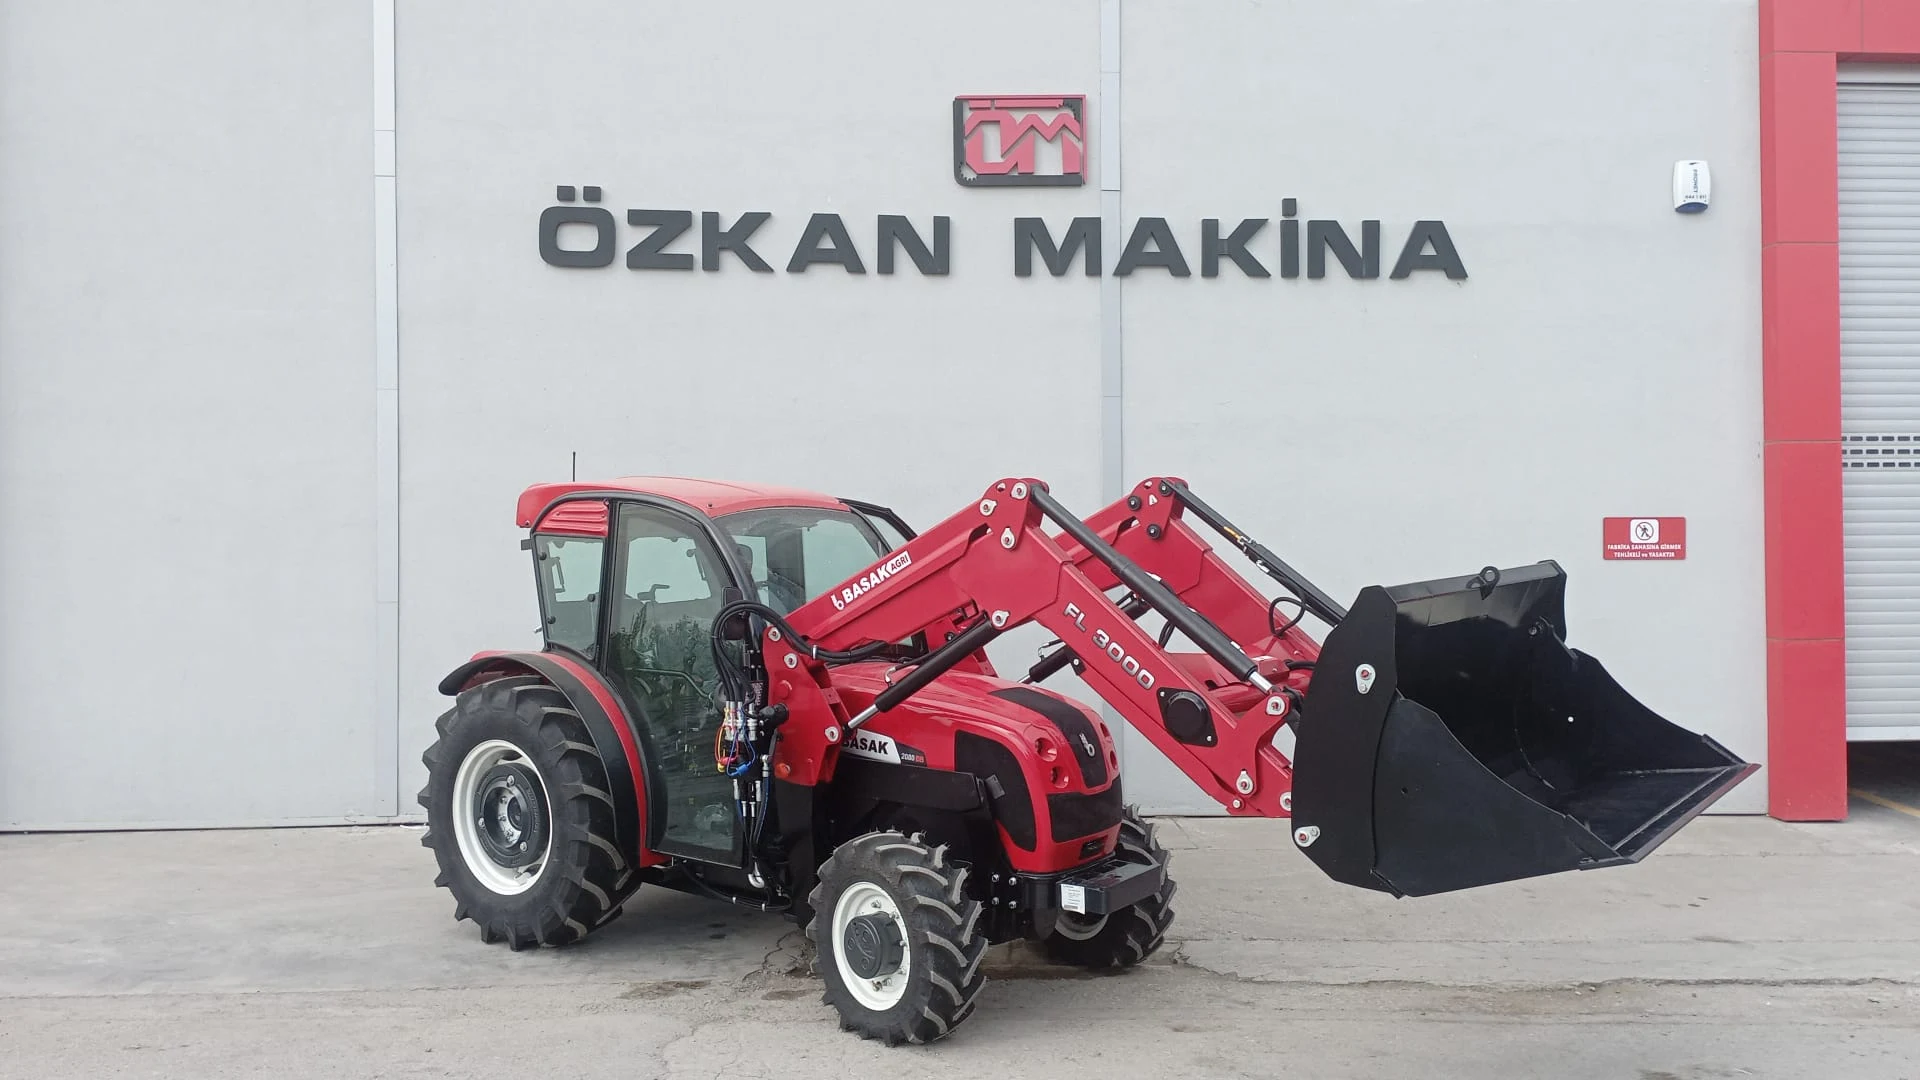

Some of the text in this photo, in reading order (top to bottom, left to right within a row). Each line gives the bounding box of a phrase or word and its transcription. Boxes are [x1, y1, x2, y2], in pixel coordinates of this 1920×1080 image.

[539, 185, 1468, 279] ÖZKAN MAKİNA
[841, 563, 891, 604] BASAK
[891, 554, 909, 572] AGRI
[1063, 602, 1155, 690] FL 3000
